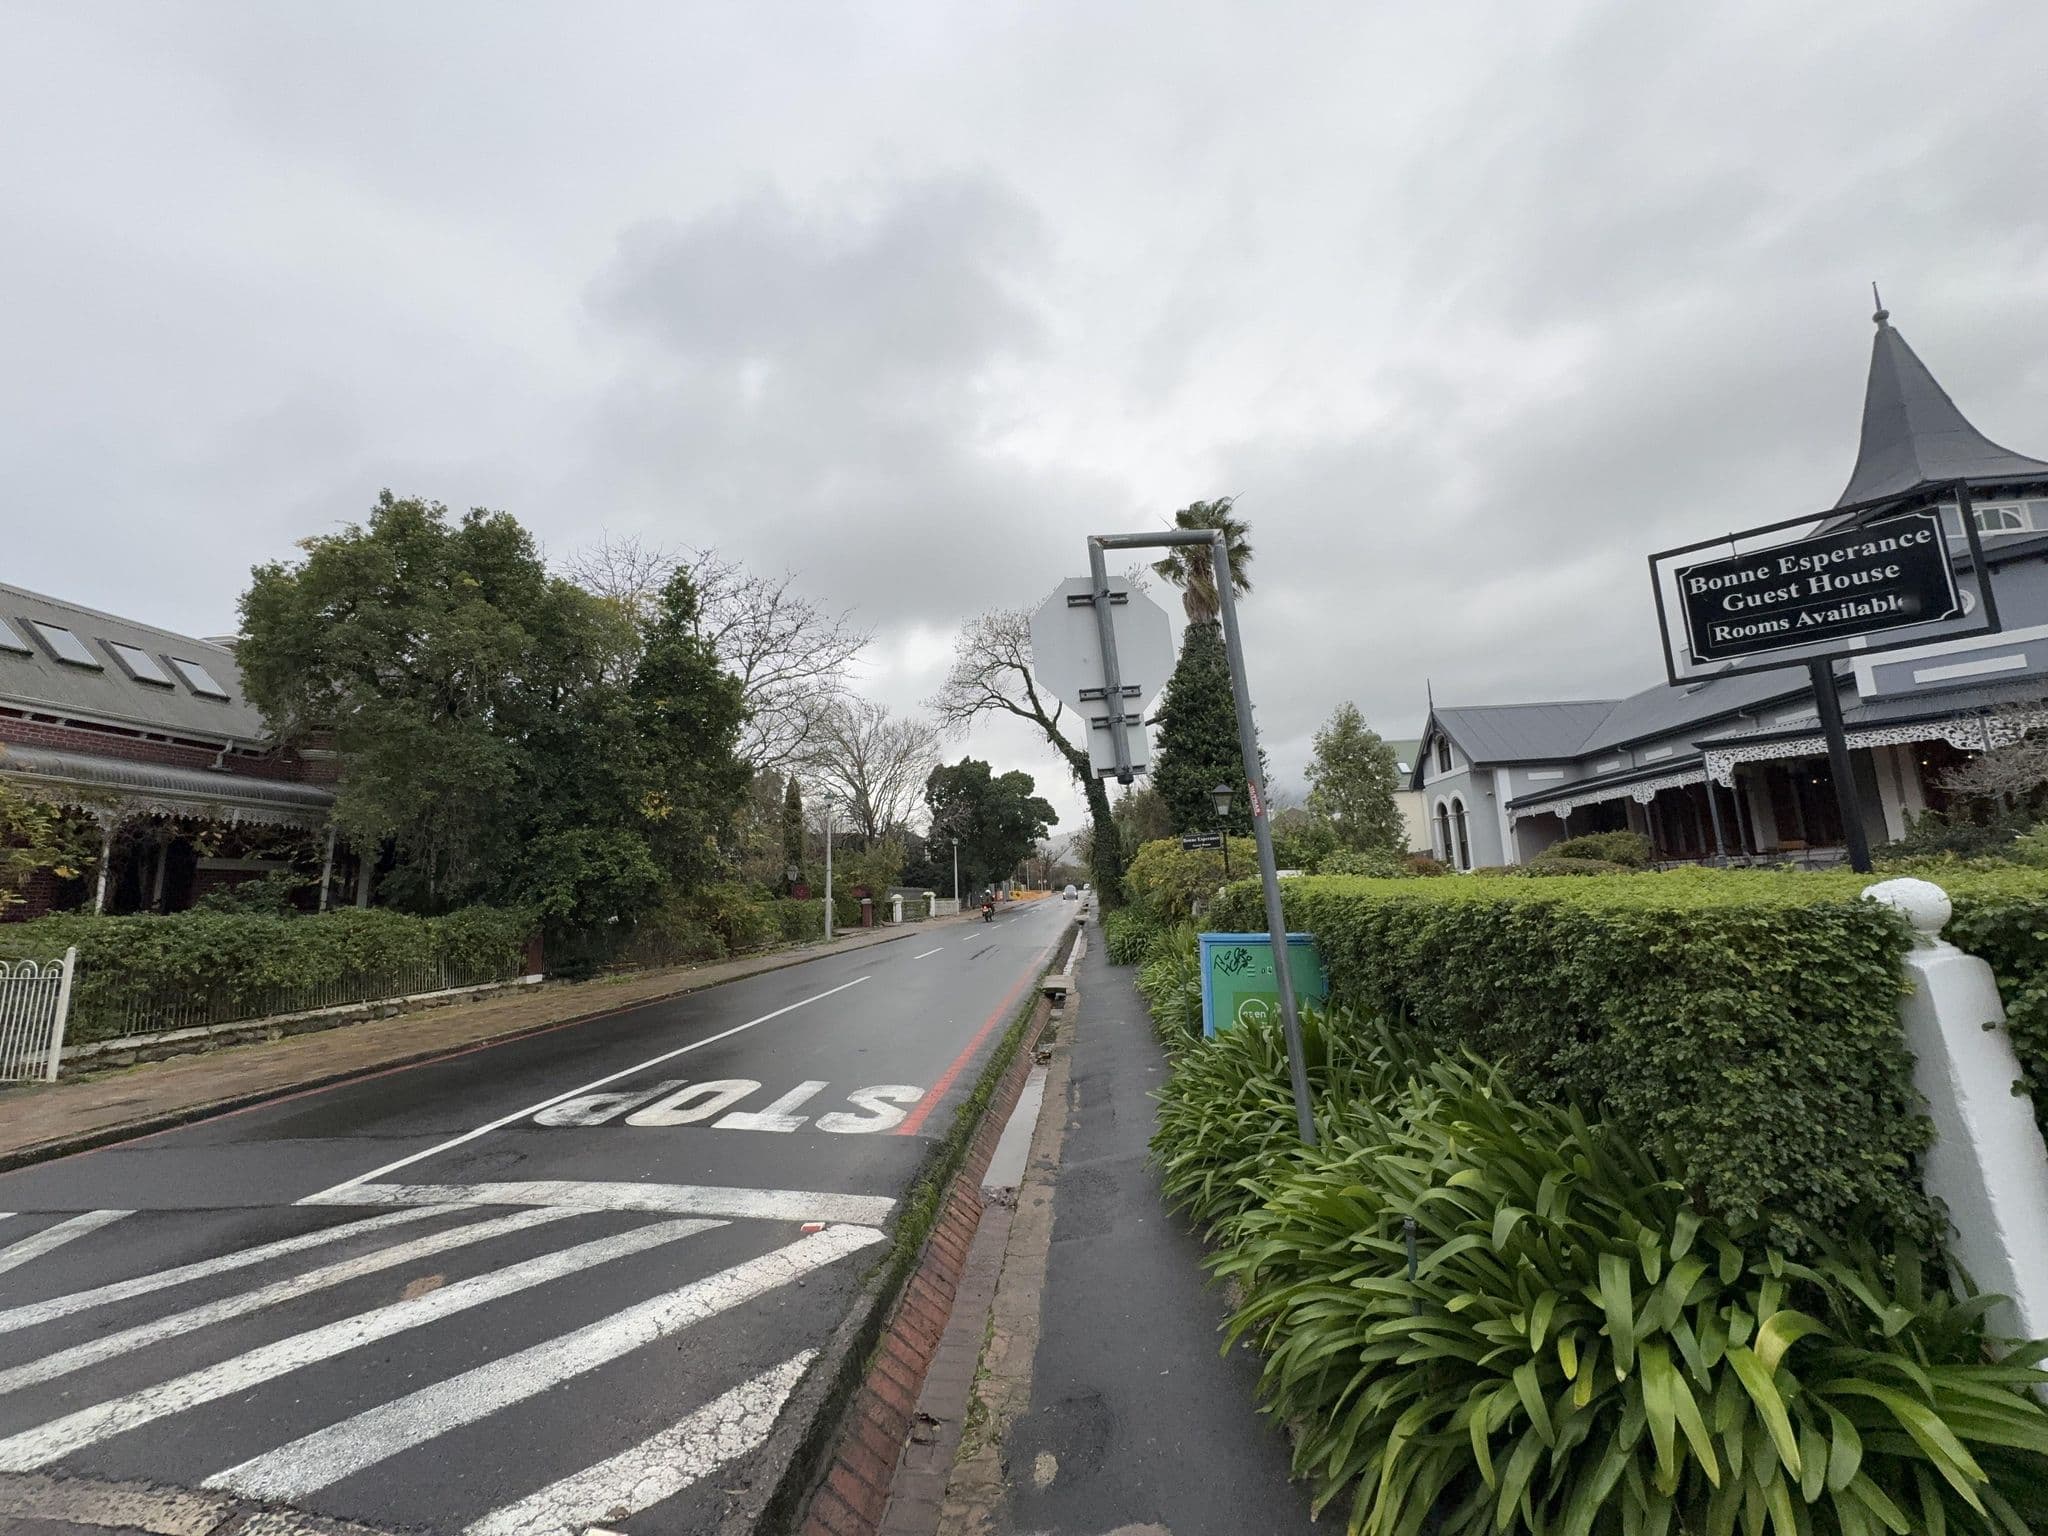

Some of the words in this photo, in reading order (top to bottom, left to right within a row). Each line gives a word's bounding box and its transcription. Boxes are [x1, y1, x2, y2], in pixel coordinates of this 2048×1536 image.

[1689, 566, 1770, 595] Bonne
[1778, 529, 1932, 577] Esperance
[1722, 584, 1799, 611] Guest
[1807, 564, 1901, 596] House
[1713, 617, 1789, 642] Rooms
[533, 1079, 926, 1134] STOP
